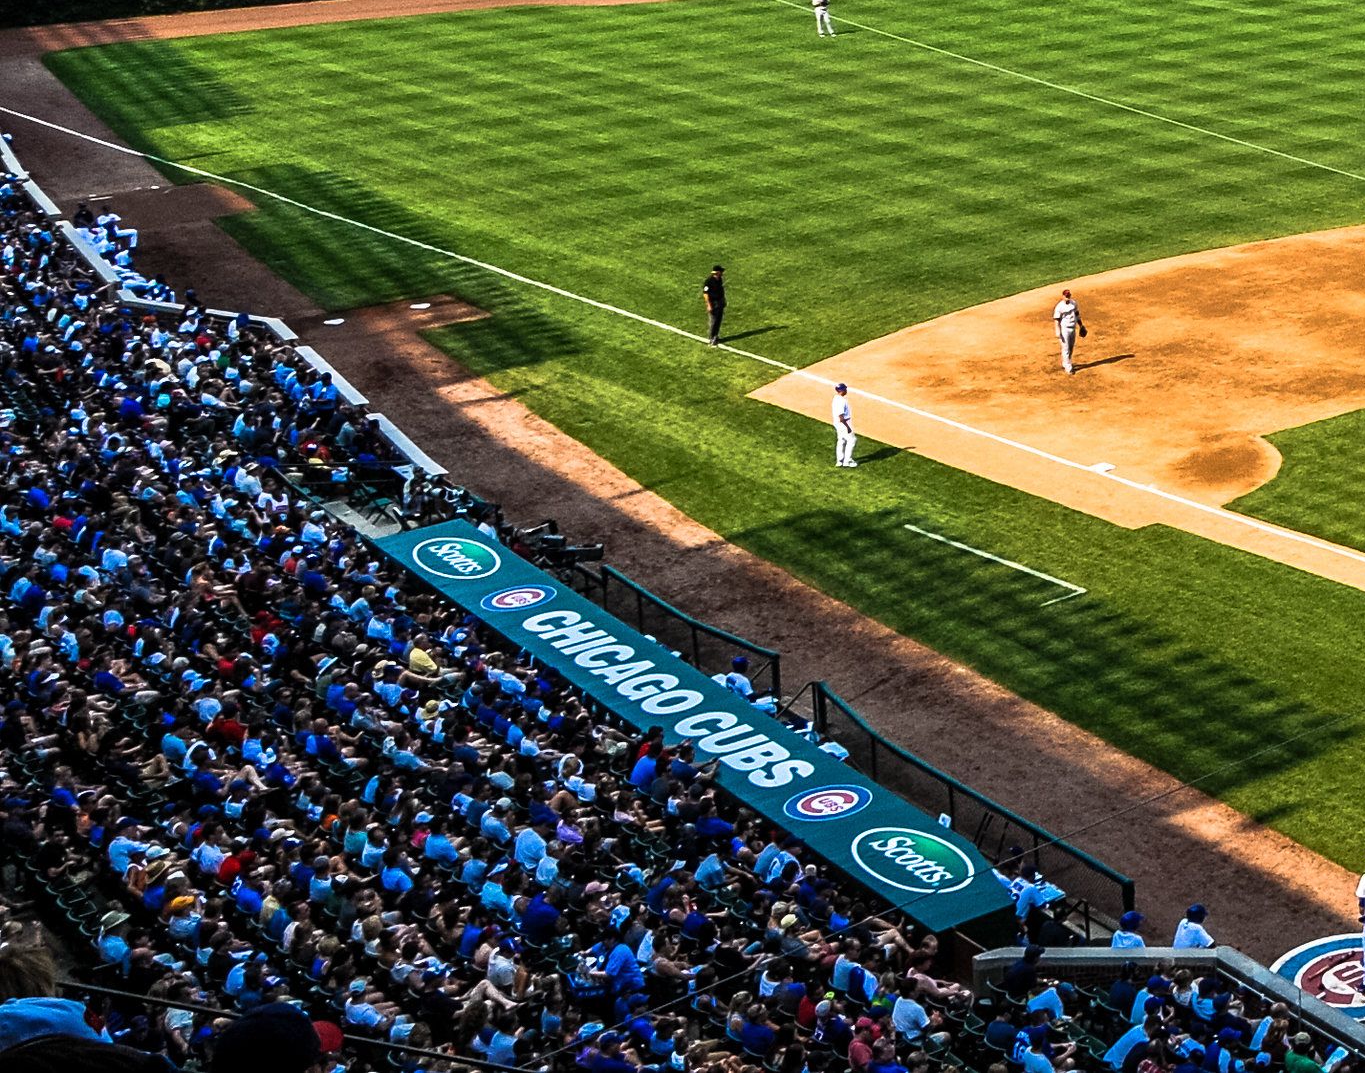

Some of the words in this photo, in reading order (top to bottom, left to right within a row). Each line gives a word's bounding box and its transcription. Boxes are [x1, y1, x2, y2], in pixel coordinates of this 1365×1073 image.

[427, 542, 483, 574] Scotts
[522, 610, 704, 715] CHICAGO
[674, 711, 815, 788] CUBS
[868, 836, 954, 886] Scotts
